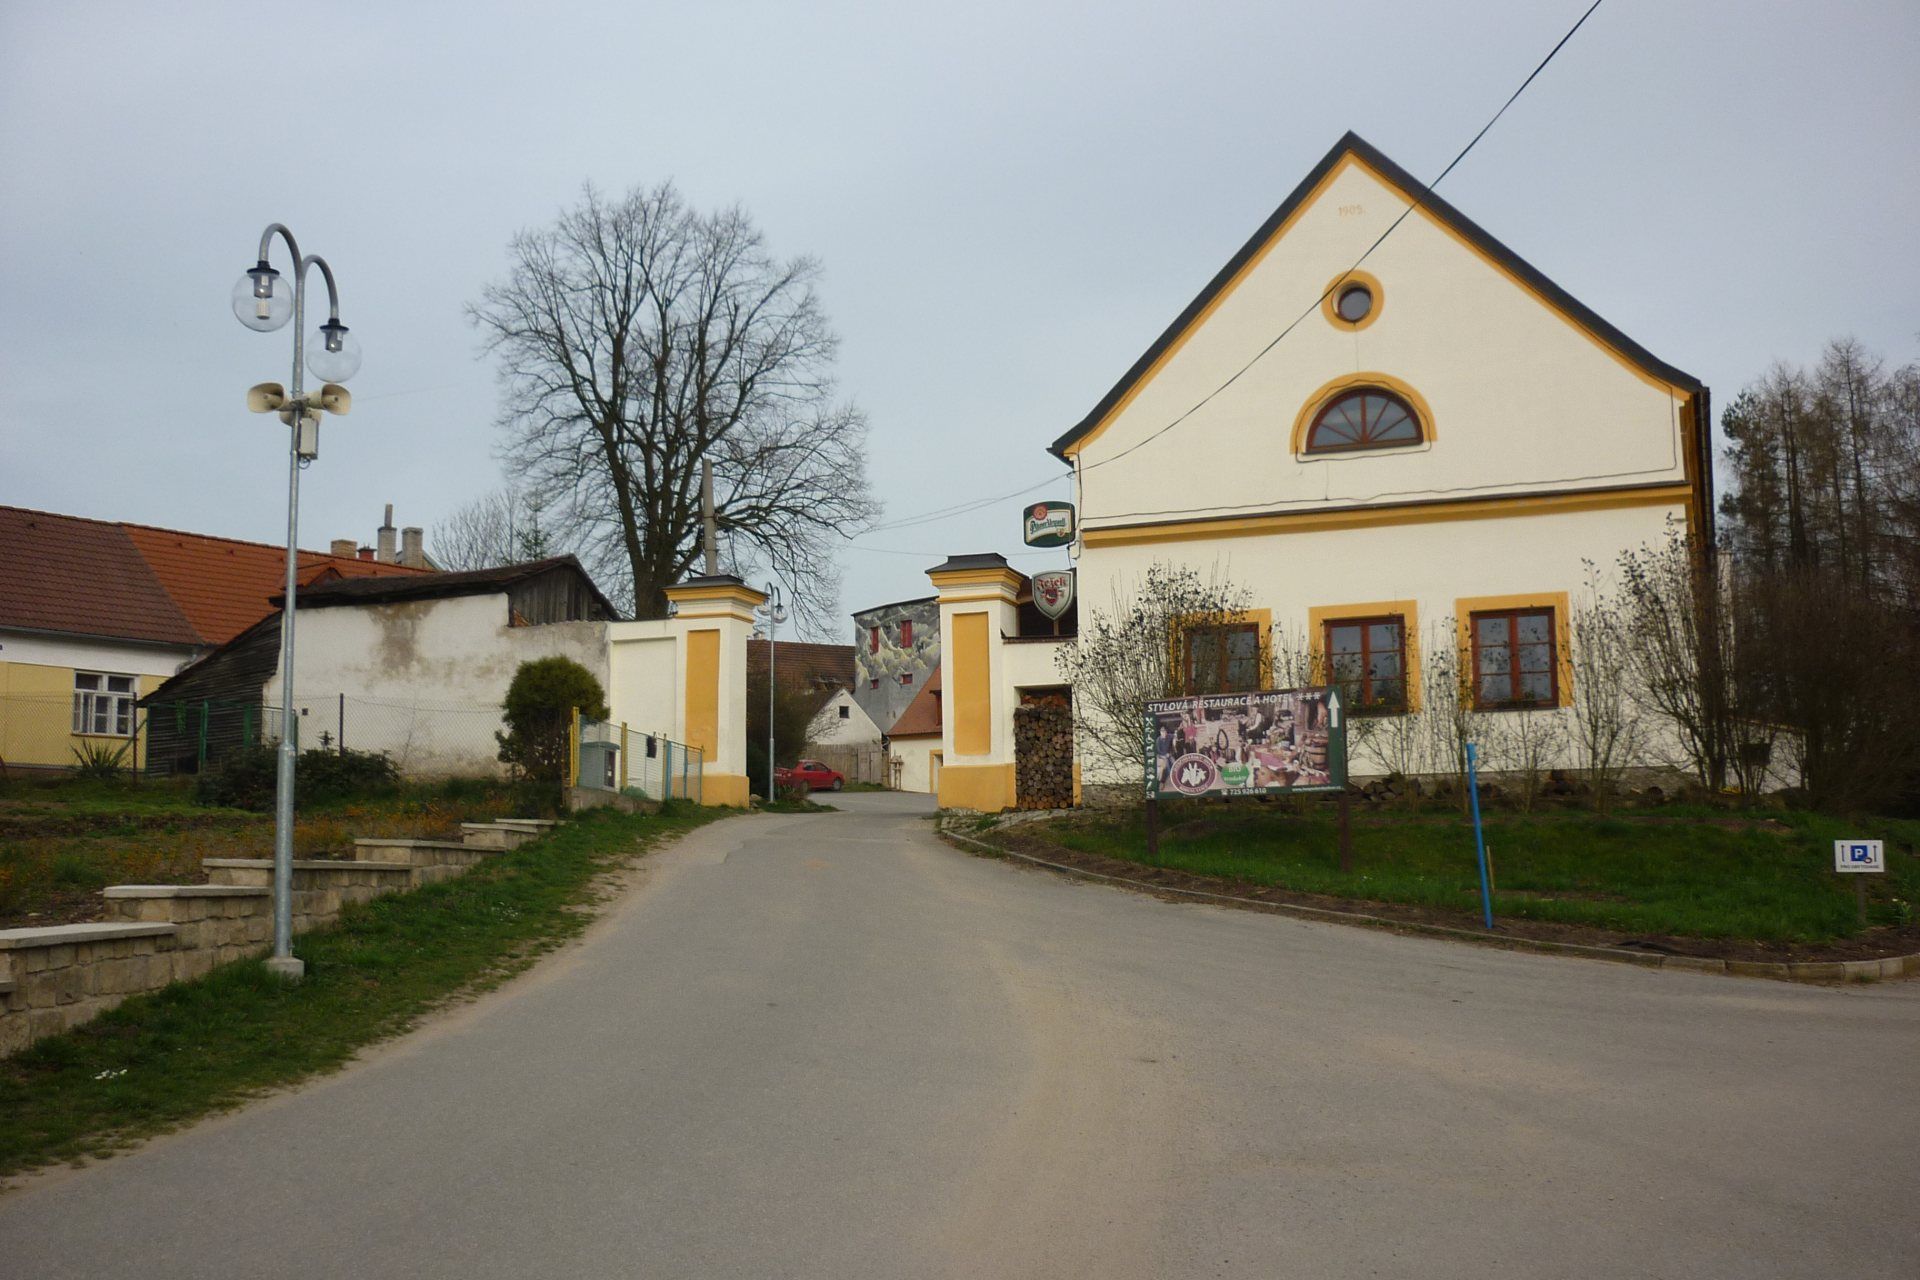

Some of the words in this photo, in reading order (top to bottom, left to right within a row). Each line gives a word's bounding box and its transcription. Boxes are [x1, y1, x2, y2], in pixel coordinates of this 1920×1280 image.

[1147, 700, 1188, 712] STYLOVÁ
[1192, 696, 1252, 709] RESTAURACE
[1253, 696, 1260, 704] A
[1262, 693, 1292, 704] HOTEL
[1854, 848, 1864, 859] P
